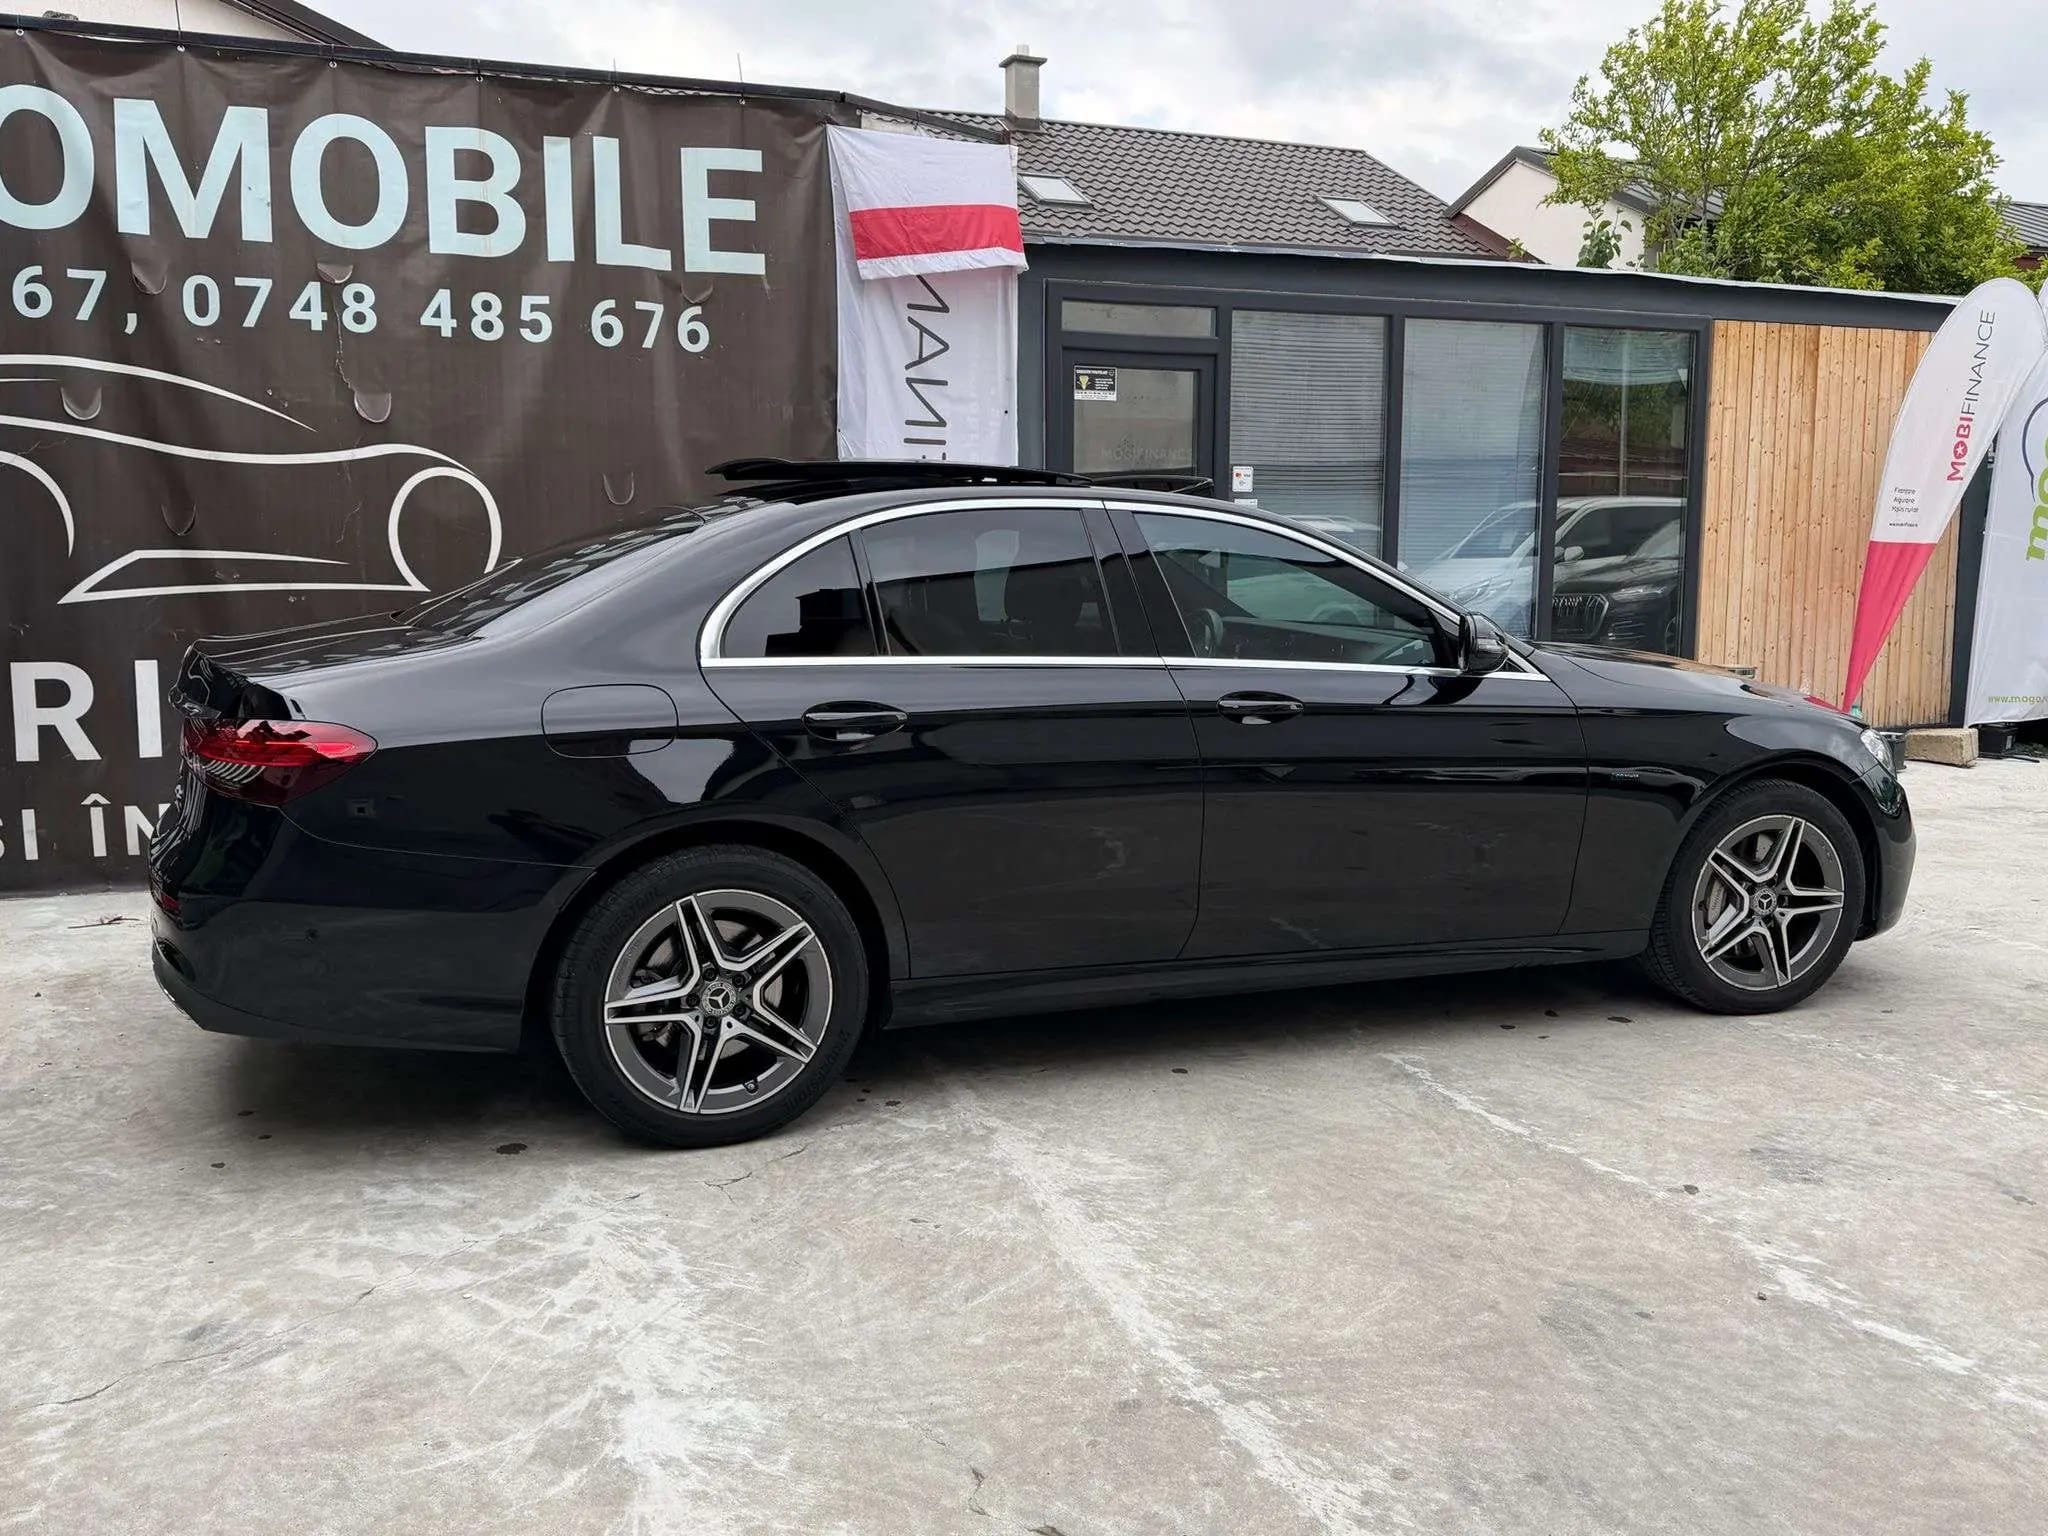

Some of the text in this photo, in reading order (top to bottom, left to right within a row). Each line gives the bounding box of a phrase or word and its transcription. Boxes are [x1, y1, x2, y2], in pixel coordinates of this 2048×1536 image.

[182, 275, 377, 333] 0748
[420, 288, 553, 343] 485
[590, 298, 710, 353] 676
[1947, 310, 1995, 481] MOBIFINANCE
[10, 659, 163, 762] RI
